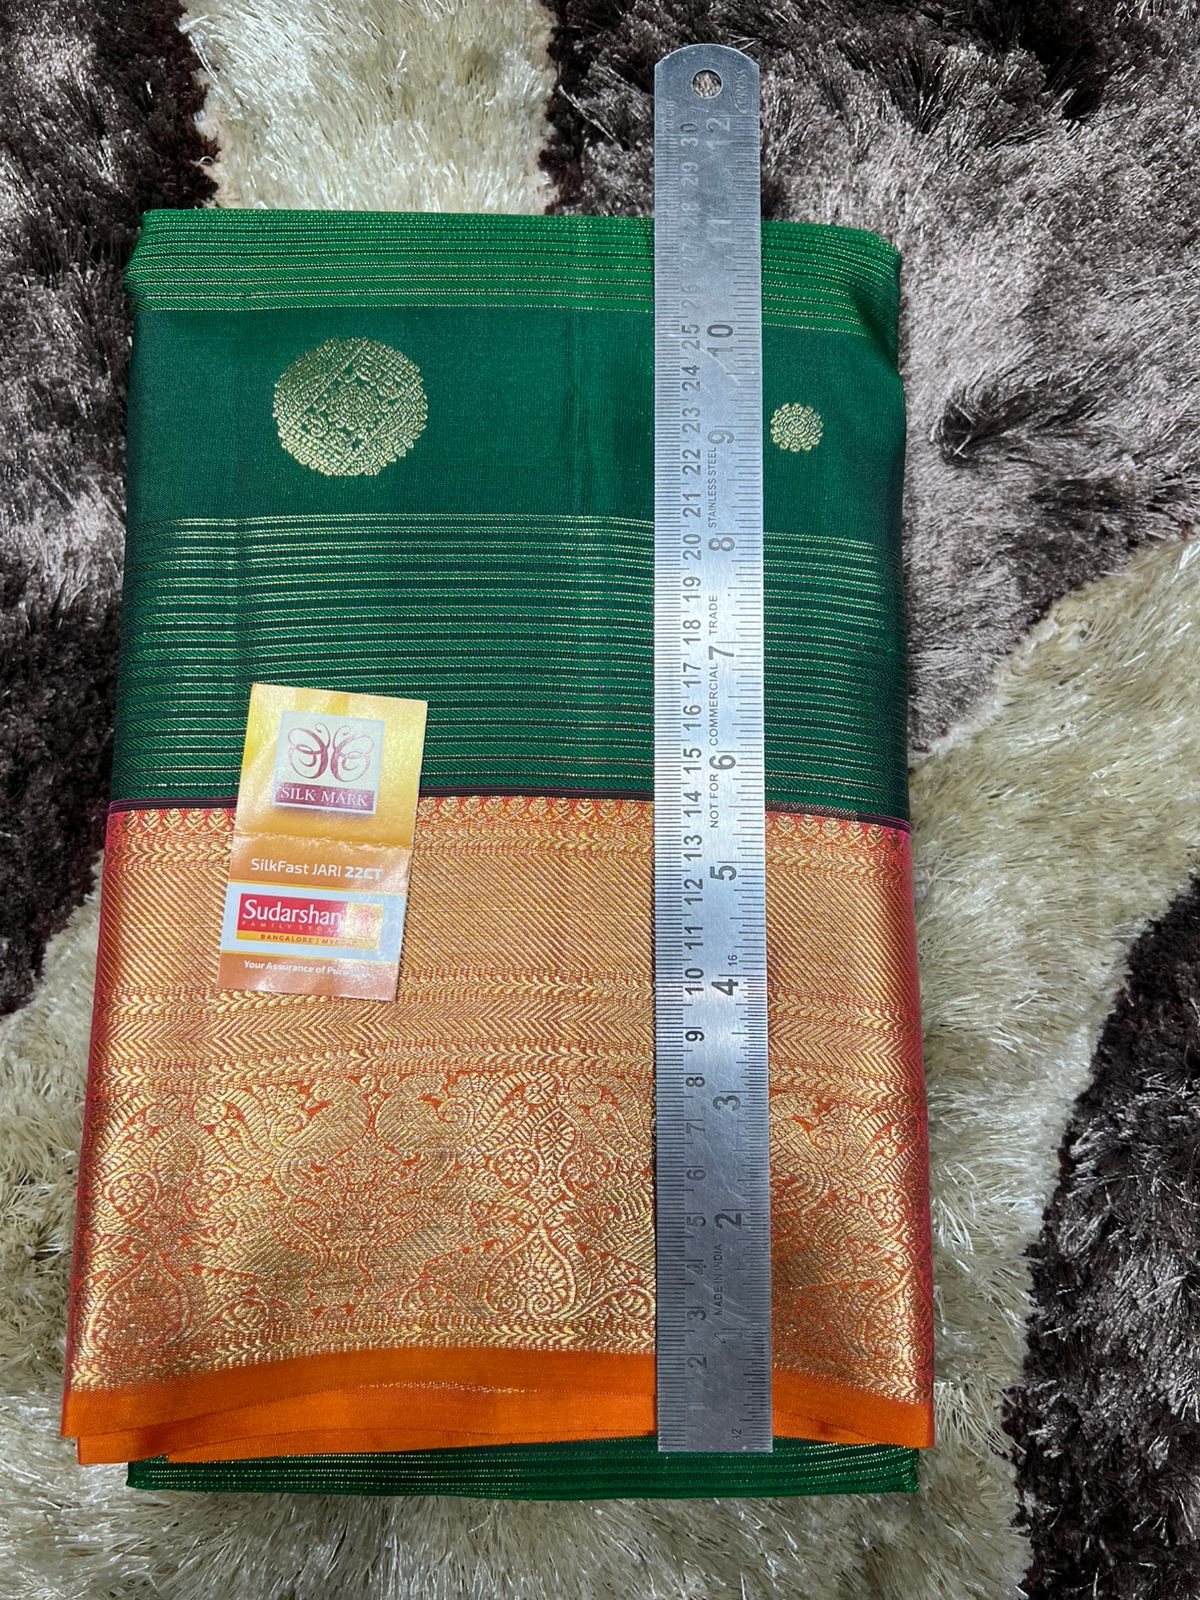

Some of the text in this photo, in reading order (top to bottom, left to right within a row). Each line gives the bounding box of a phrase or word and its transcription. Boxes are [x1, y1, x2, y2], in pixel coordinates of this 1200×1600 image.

[681, 324, 700, 350] 25
[706, 324, 734, 357] 10
[681, 365, 700, 392] 24
[682, 407, 701, 433] 23
[707, 429, 735, 445] 9
[682, 448, 701, 476] 22
[708, 447, 717, 528] STAINLESS STEEL
[682, 492, 701, 518] 21
[682, 533, 702, 561] 20
[708, 536, 736, 552] 8
[682, 576, 702, 603] 19
[682, 619, 702, 645] 18
[708, 645, 735, 660] 7
[683, 662, 702, 688] 17
[683, 704, 702, 731] 16
[708, 594, 719, 828] NOT FOR COMMERCIAL TRADE
[683, 747, 702, 775] 15
[709, 754, 736, 770] 6
[280, 786, 369, 807] SILK MARK
[683, 790, 702, 818] 14
[683, 834, 703, 861] 13
[250, 858, 384, 880] SilkFast JARI 22CT
[710, 865, 737, 881] 5
[684, 878, 703, 906] 12
[242, 899, 344, 926] Sudarshan
[241, 920, 292, 931] FAMILY
[259, 933, 313, 945] BANGALORE
[684, 926, 703, 950] 11
[243, 960, 265, 971] Your
[265, 962, 315, 974] Assurance
[315, 965, 327, 974] of
[727, 954, 738, 966] 16
[684, 967, 704, 995] 10
[711, 978, 739, 996] 4
[685, 1030, 705, 1042] 9
[685, 1076, 705, 1088] 8
[712, 1095, 741, 1111] 3
[686, 1122, 706, 1134] 7
[686, 1169, 706, 1181] 6
[686, 1215, 706, 1227] 5
[713, 1213, 742, 1231] 2
[713, 1244, 723, 1316] MADE IN INDIA
[687, 1309, 707, 1321] 3
[687, 1356, 708, 1369] 2
